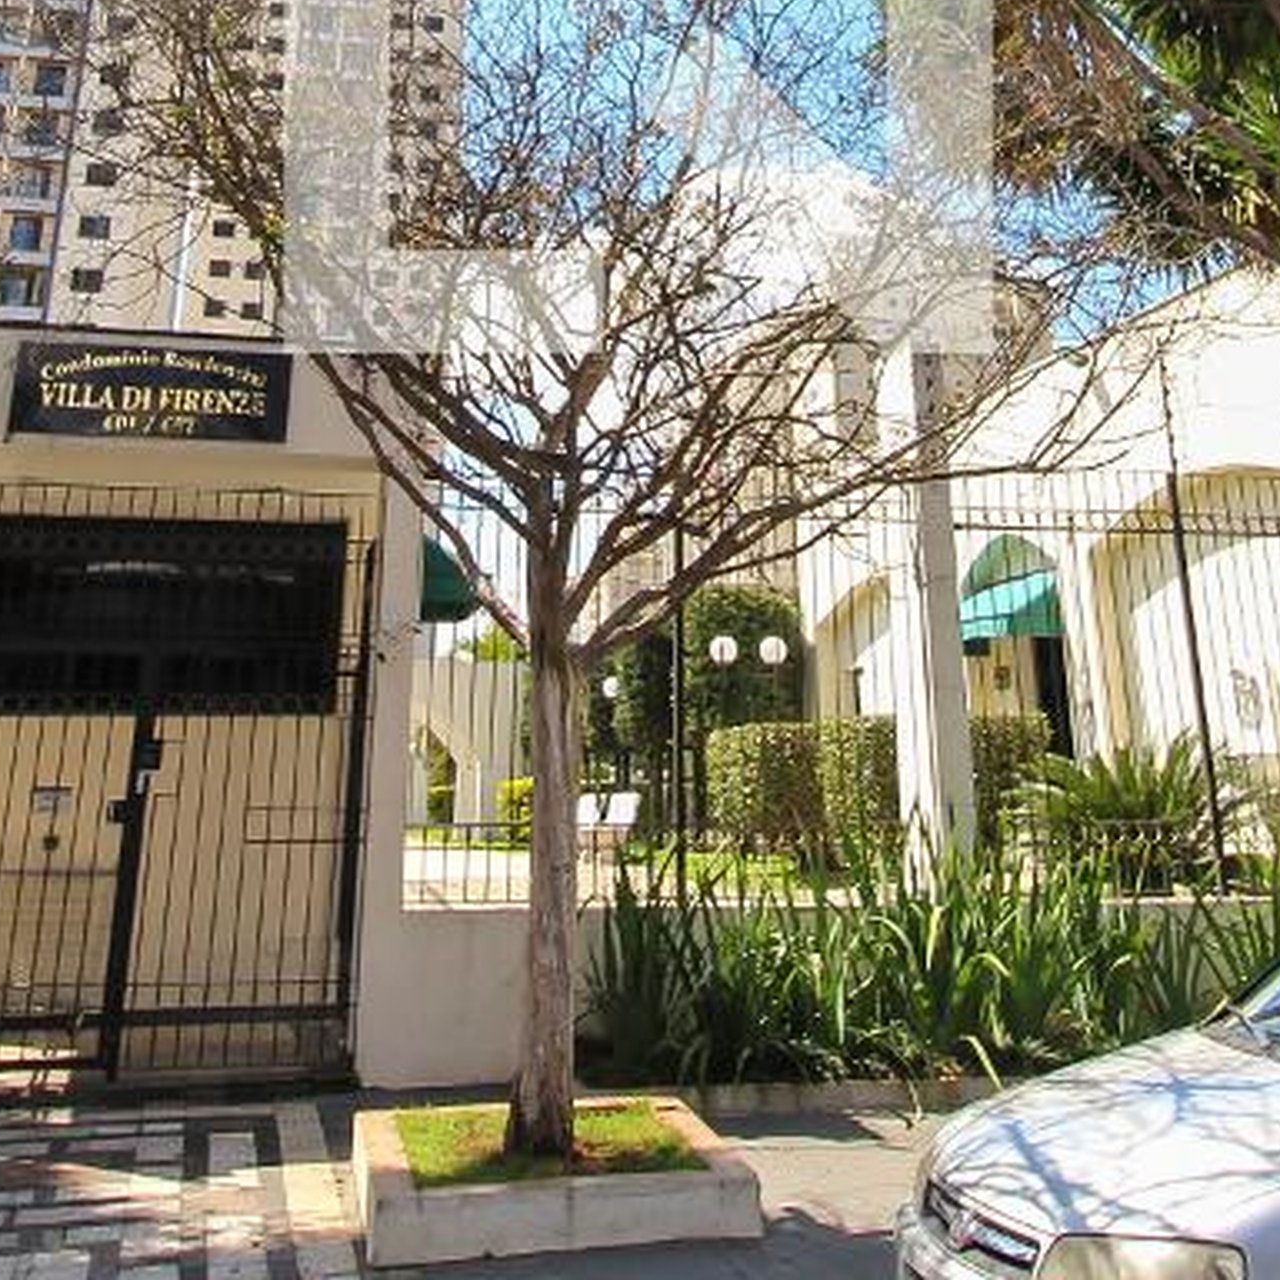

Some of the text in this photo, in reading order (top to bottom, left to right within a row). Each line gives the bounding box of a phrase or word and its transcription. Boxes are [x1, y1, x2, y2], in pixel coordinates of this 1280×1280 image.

[39, 382, 266, 417] VILLA DI FIRENZE
